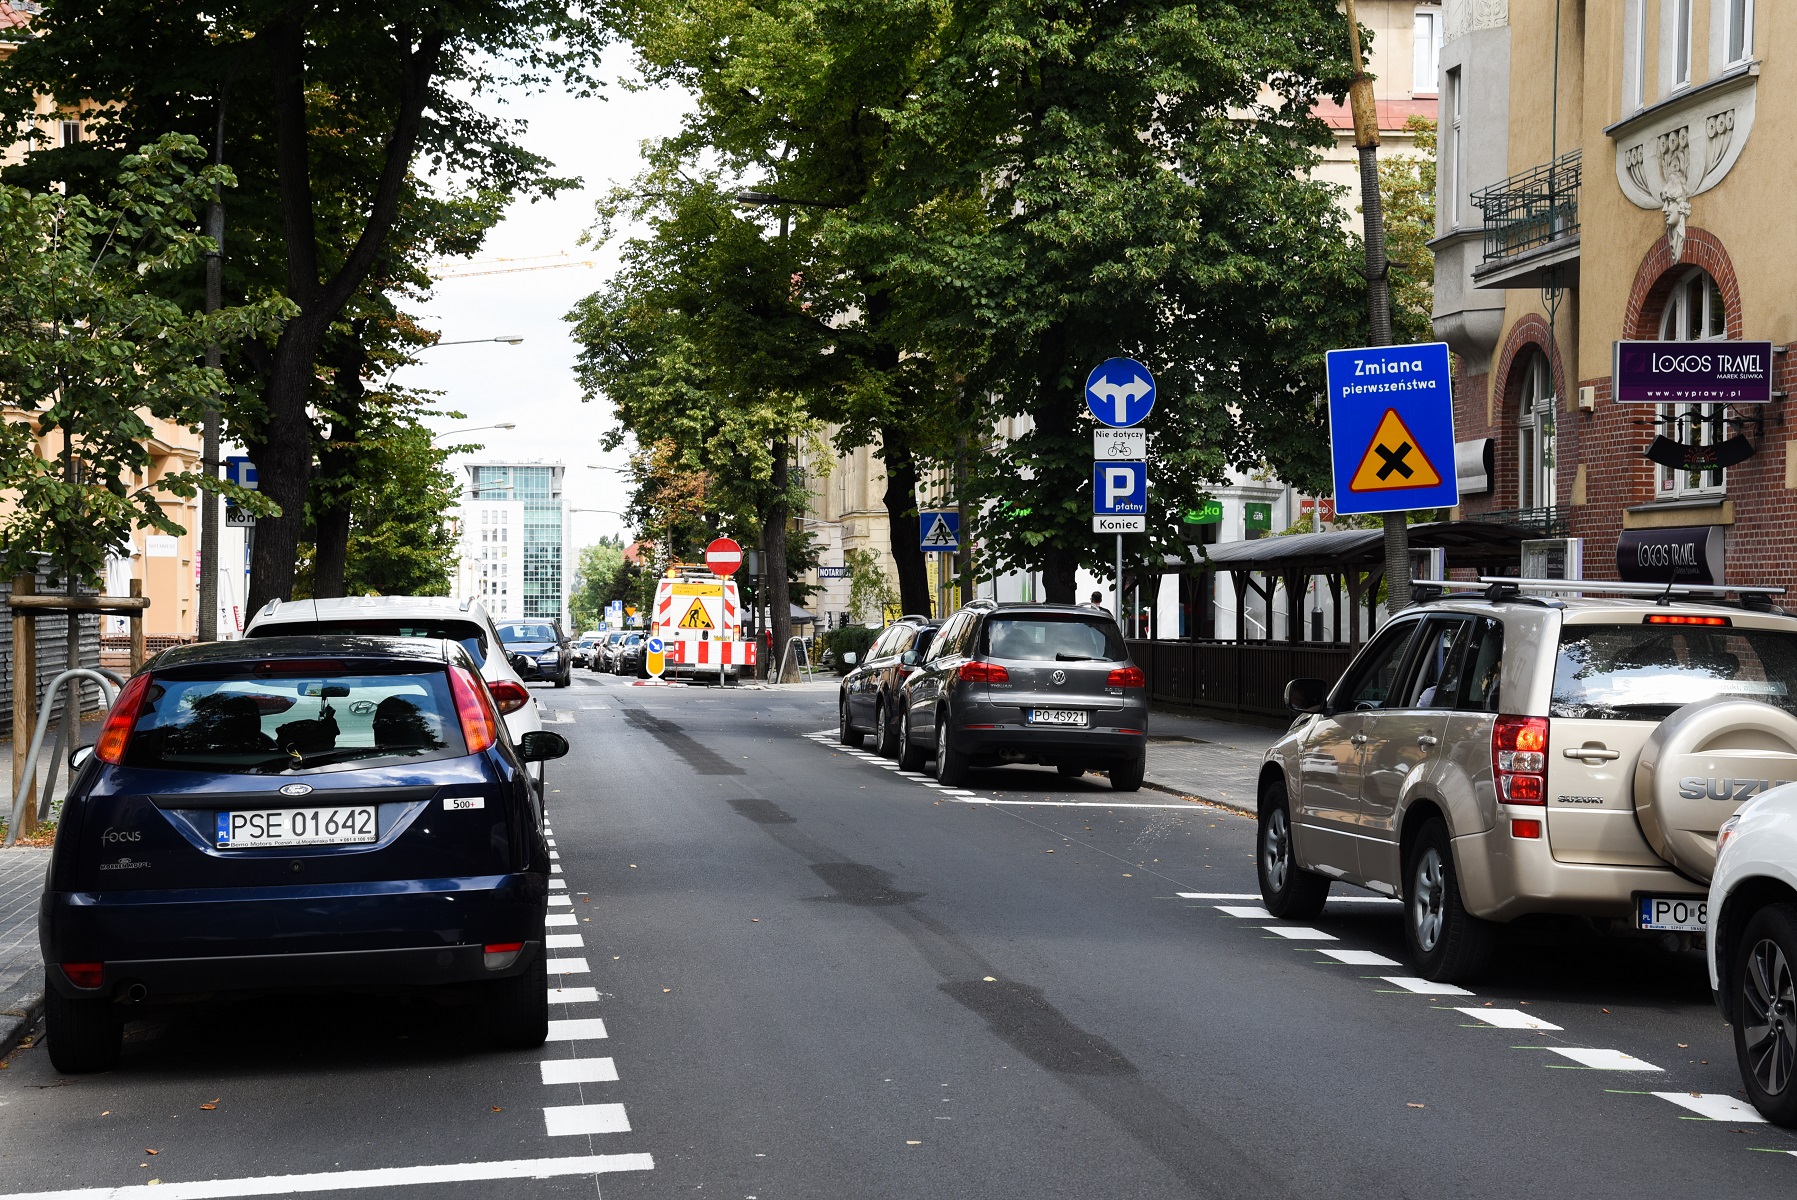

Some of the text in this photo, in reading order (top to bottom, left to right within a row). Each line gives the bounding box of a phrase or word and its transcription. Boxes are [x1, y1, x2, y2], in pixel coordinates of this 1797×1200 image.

[1354, 358, 1423, 376] Zmiana
[1652, 352, 1764, 373] LOGOS TRAVEL
[1342, 378, 1436, 398] pierwszeństwa
[1095, 430, 1144, 439] Nie dotyczy
[1105, 467, 1135, 508] P
[1115, 502, 1143, 512] płatny
[227, 513, 255, 523] Kon
[1099, 519, 1139, 529] Koniec
[1637, 542, 1698, 567] LOGOS TRAVEL
[1034, 710, 1084, 722] PO 4S921
[1679, 776, 1794, 801] SUZ
[453, 799, 475, 809] 500+
[1558, 795, 1604, 804] SUZUKI
[231, 809, 372, 840] PSE 01642
[1656, 901, 1708, 925] PO 8
